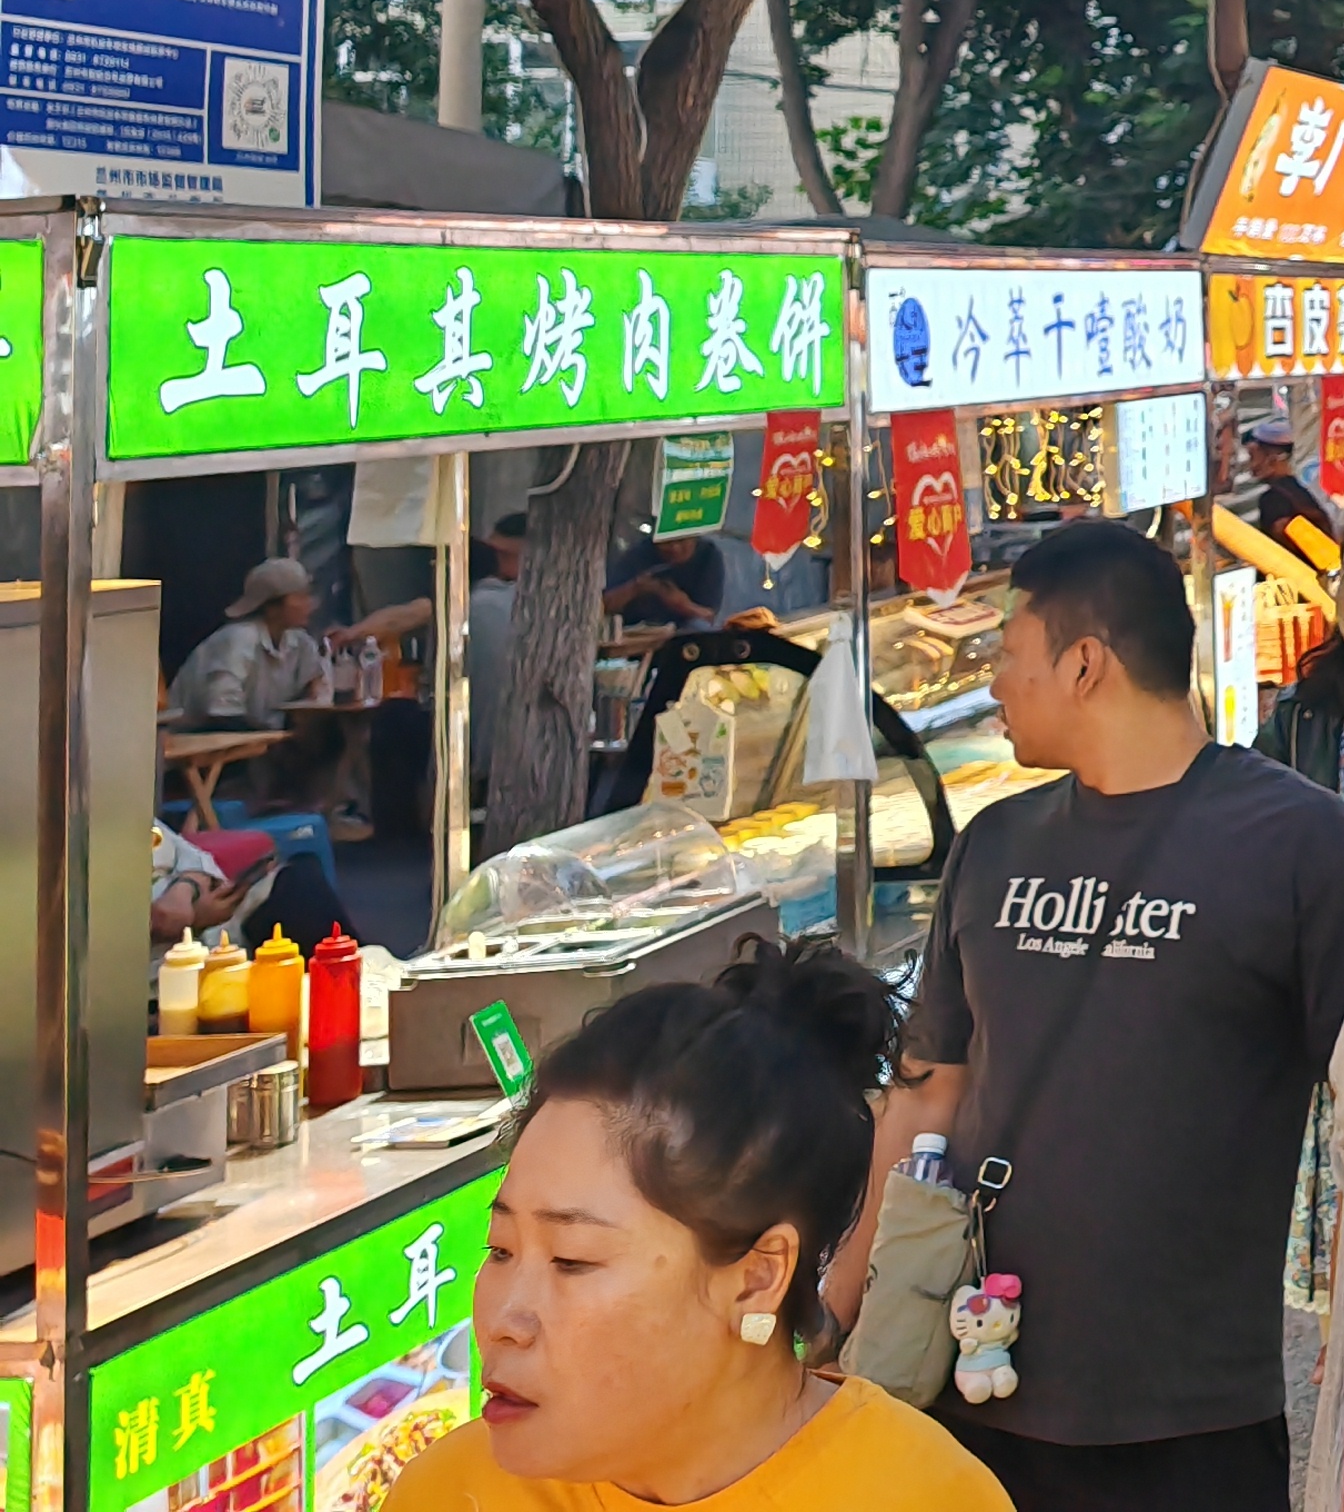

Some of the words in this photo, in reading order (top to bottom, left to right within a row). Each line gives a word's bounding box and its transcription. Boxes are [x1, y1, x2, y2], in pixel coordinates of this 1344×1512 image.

[159, 265, 831, 429] 土耳其烤肉卷饼
[114, 1369, 217, 1481] 清真
